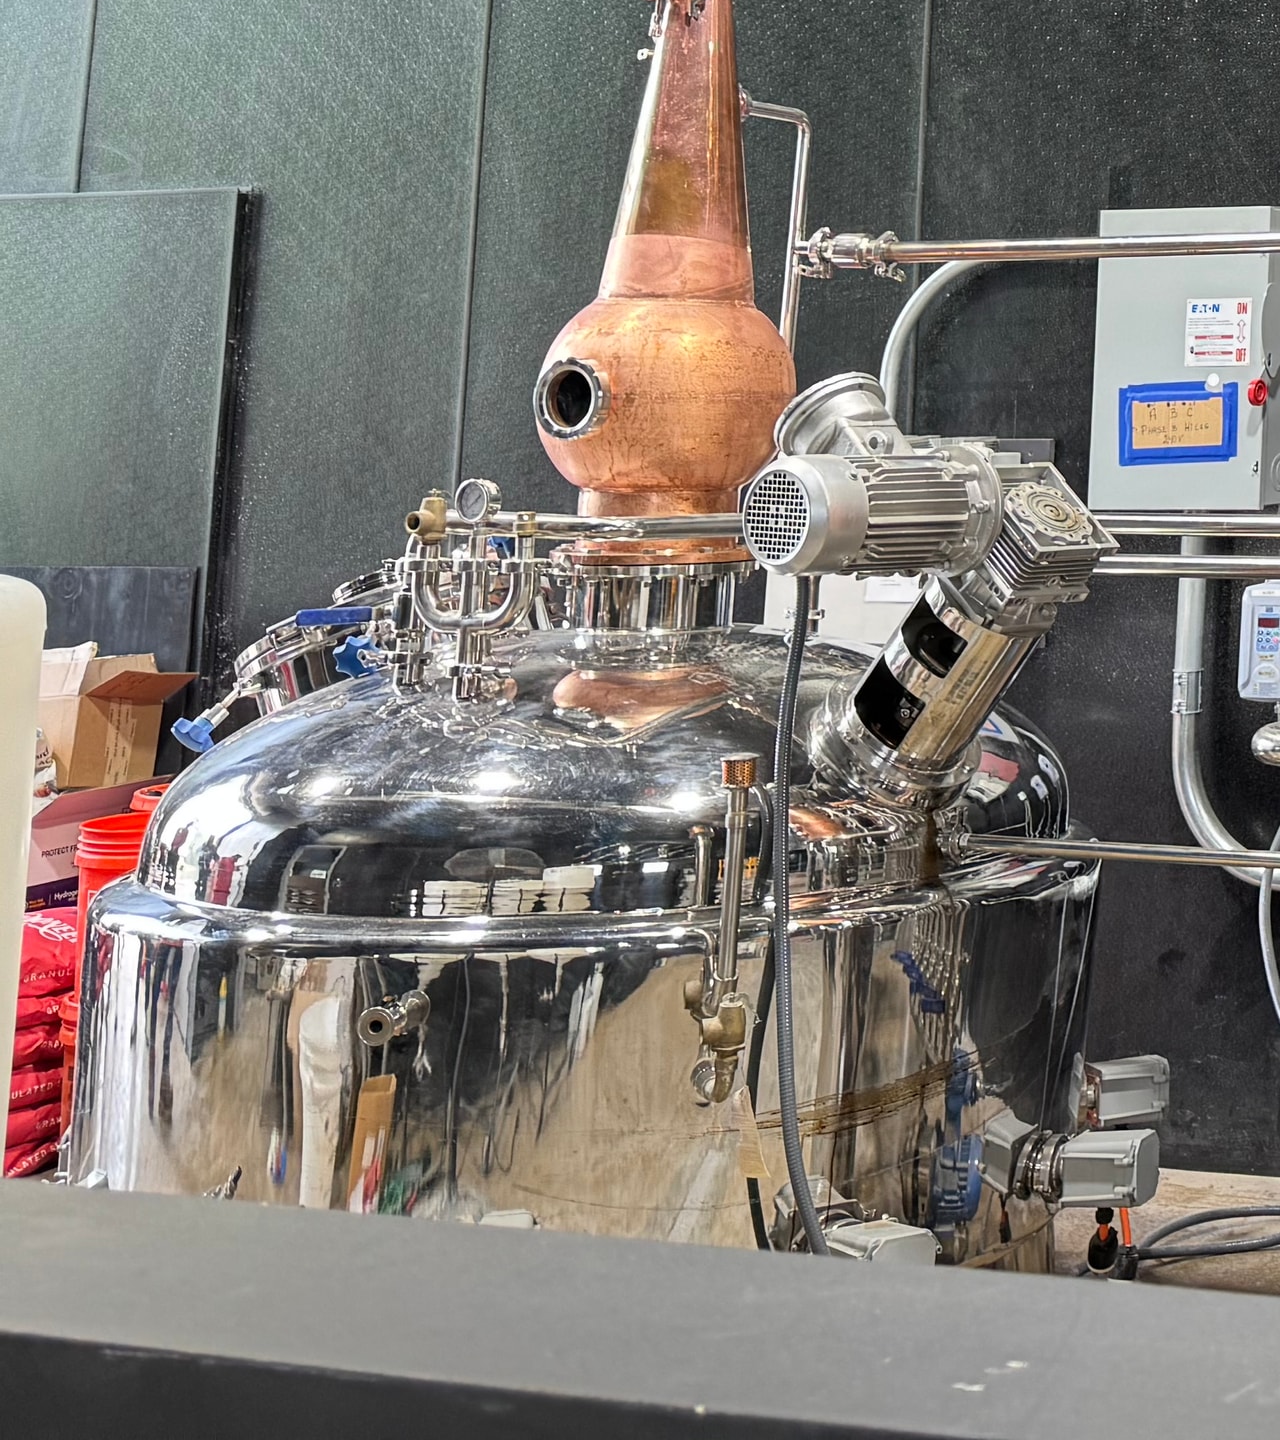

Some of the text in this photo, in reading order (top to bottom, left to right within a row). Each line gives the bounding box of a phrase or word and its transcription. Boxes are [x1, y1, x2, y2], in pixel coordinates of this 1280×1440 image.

[1237, 302, 1248, 315] ON
[1236, 348, 1247, 362] OFF
[1149, 407, 1193, 421] A B C
[41, 845, 69, 858] PROTECT
